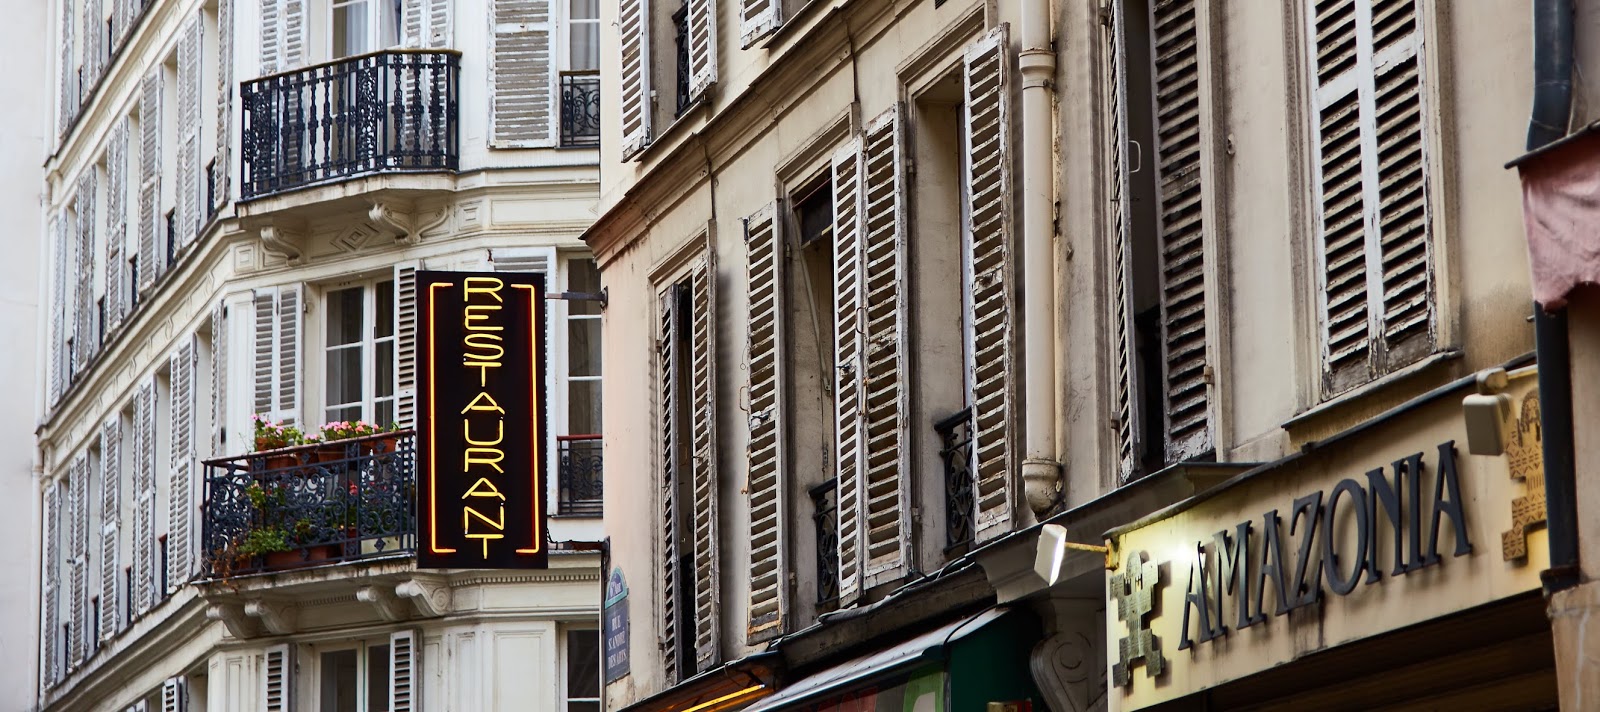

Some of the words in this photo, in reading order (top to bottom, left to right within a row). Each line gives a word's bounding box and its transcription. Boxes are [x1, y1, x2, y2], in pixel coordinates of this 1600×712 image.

[461, 277, 506, 559] RESTAURANT
[612, 615, 621, 631] RUE
[1178, 439, 1473, 651] AMAZONIA
